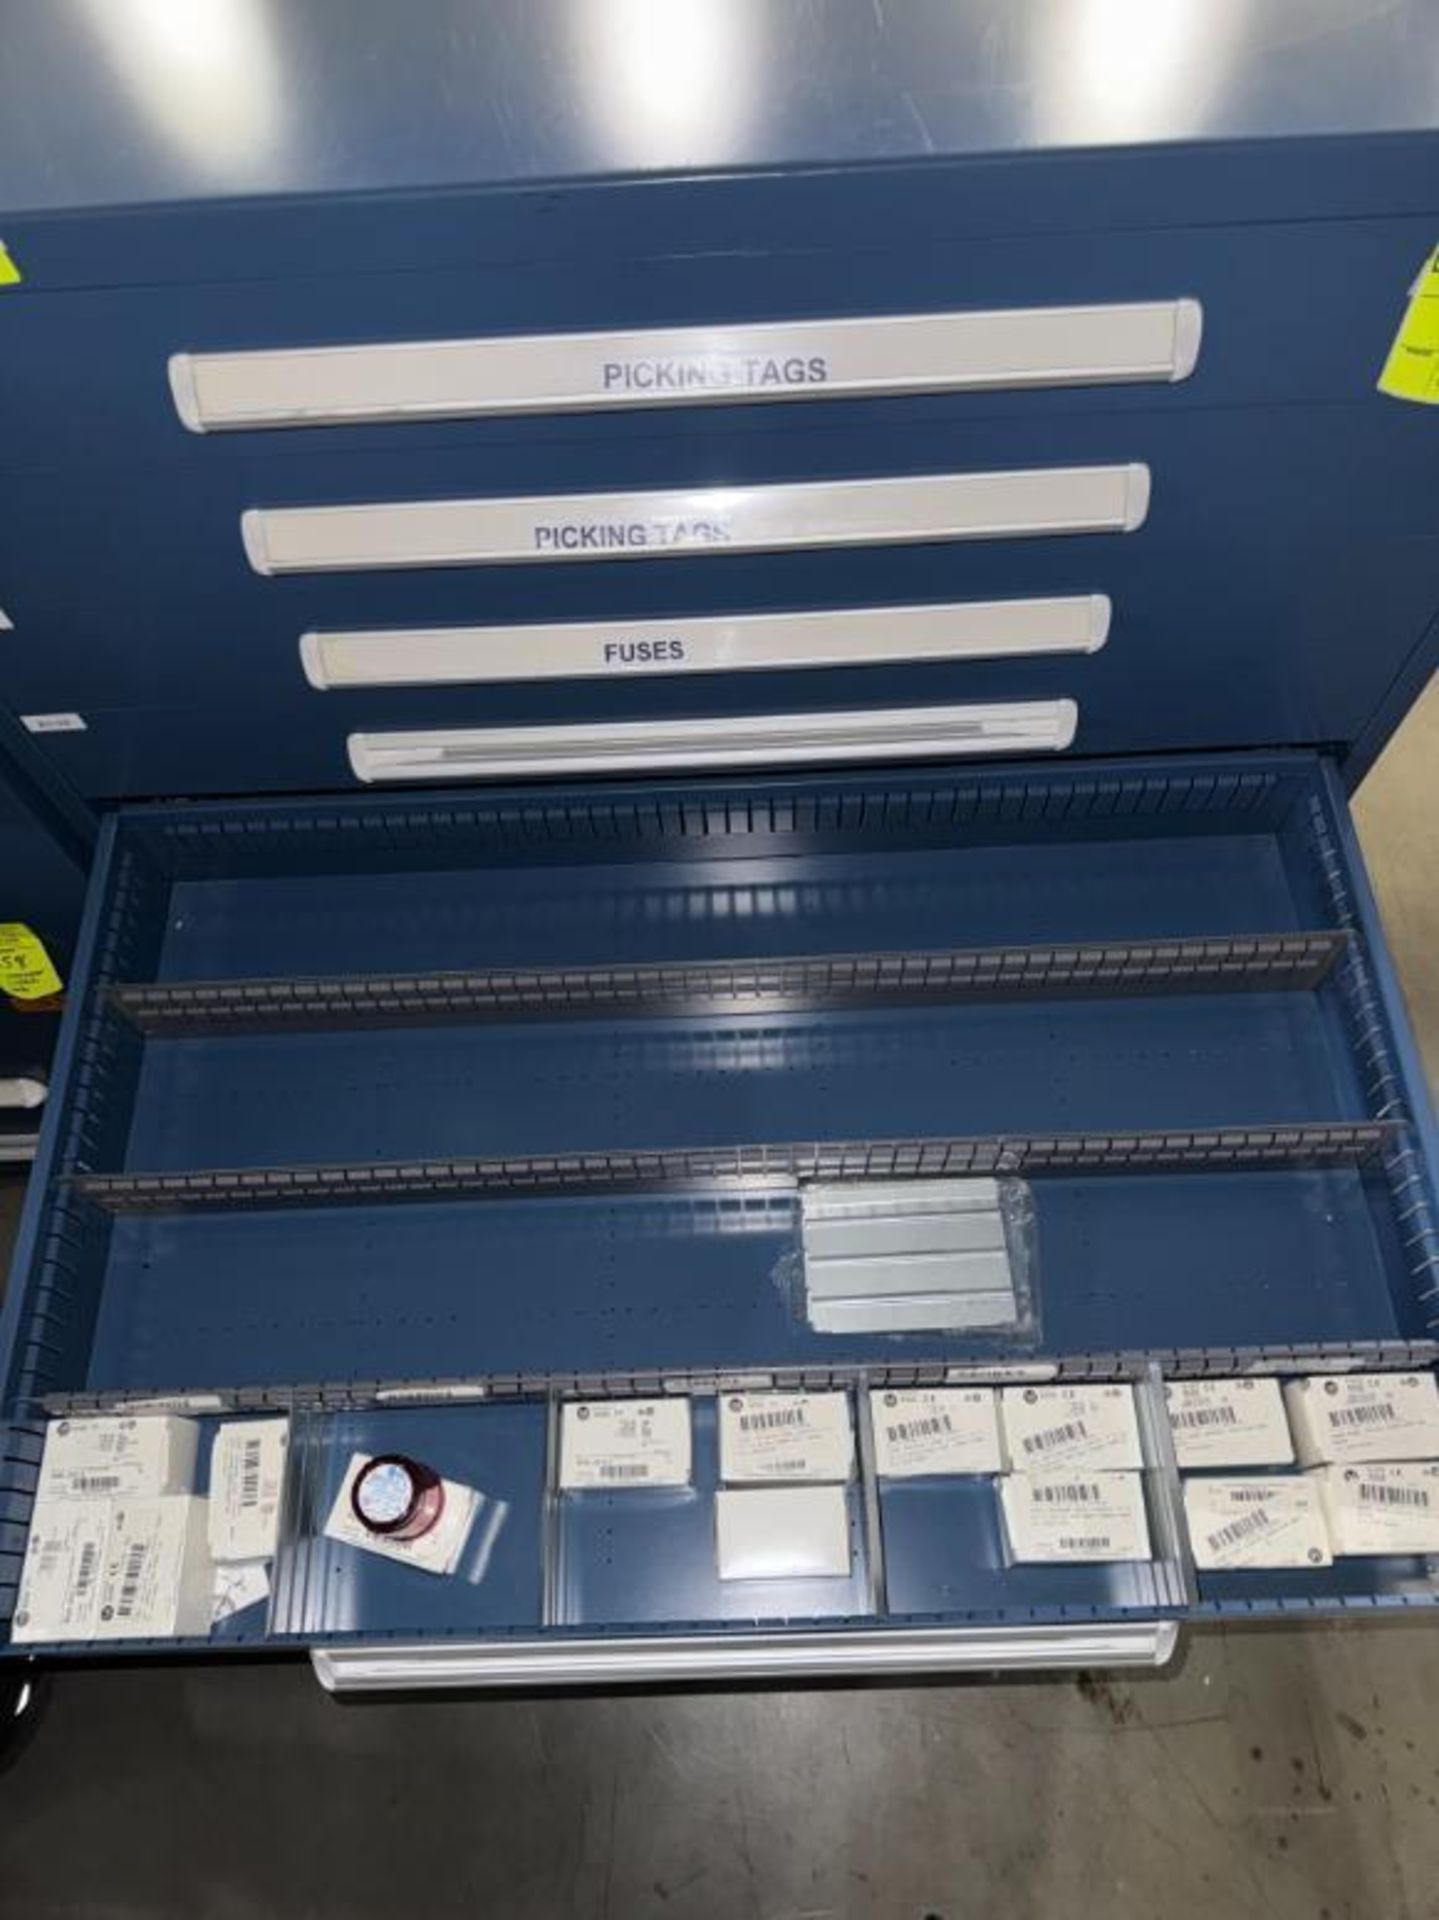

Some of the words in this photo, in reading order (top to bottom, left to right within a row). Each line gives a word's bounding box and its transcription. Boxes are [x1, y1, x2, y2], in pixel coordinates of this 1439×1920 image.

[603, 362, 735, 388] PICKING
[743, 358, 827, 383] TAGS
[535, 524, 647, 549] PICKING
[653, 521, 731, 545] TAGS
[604, 640, 684, 662] FUSES
